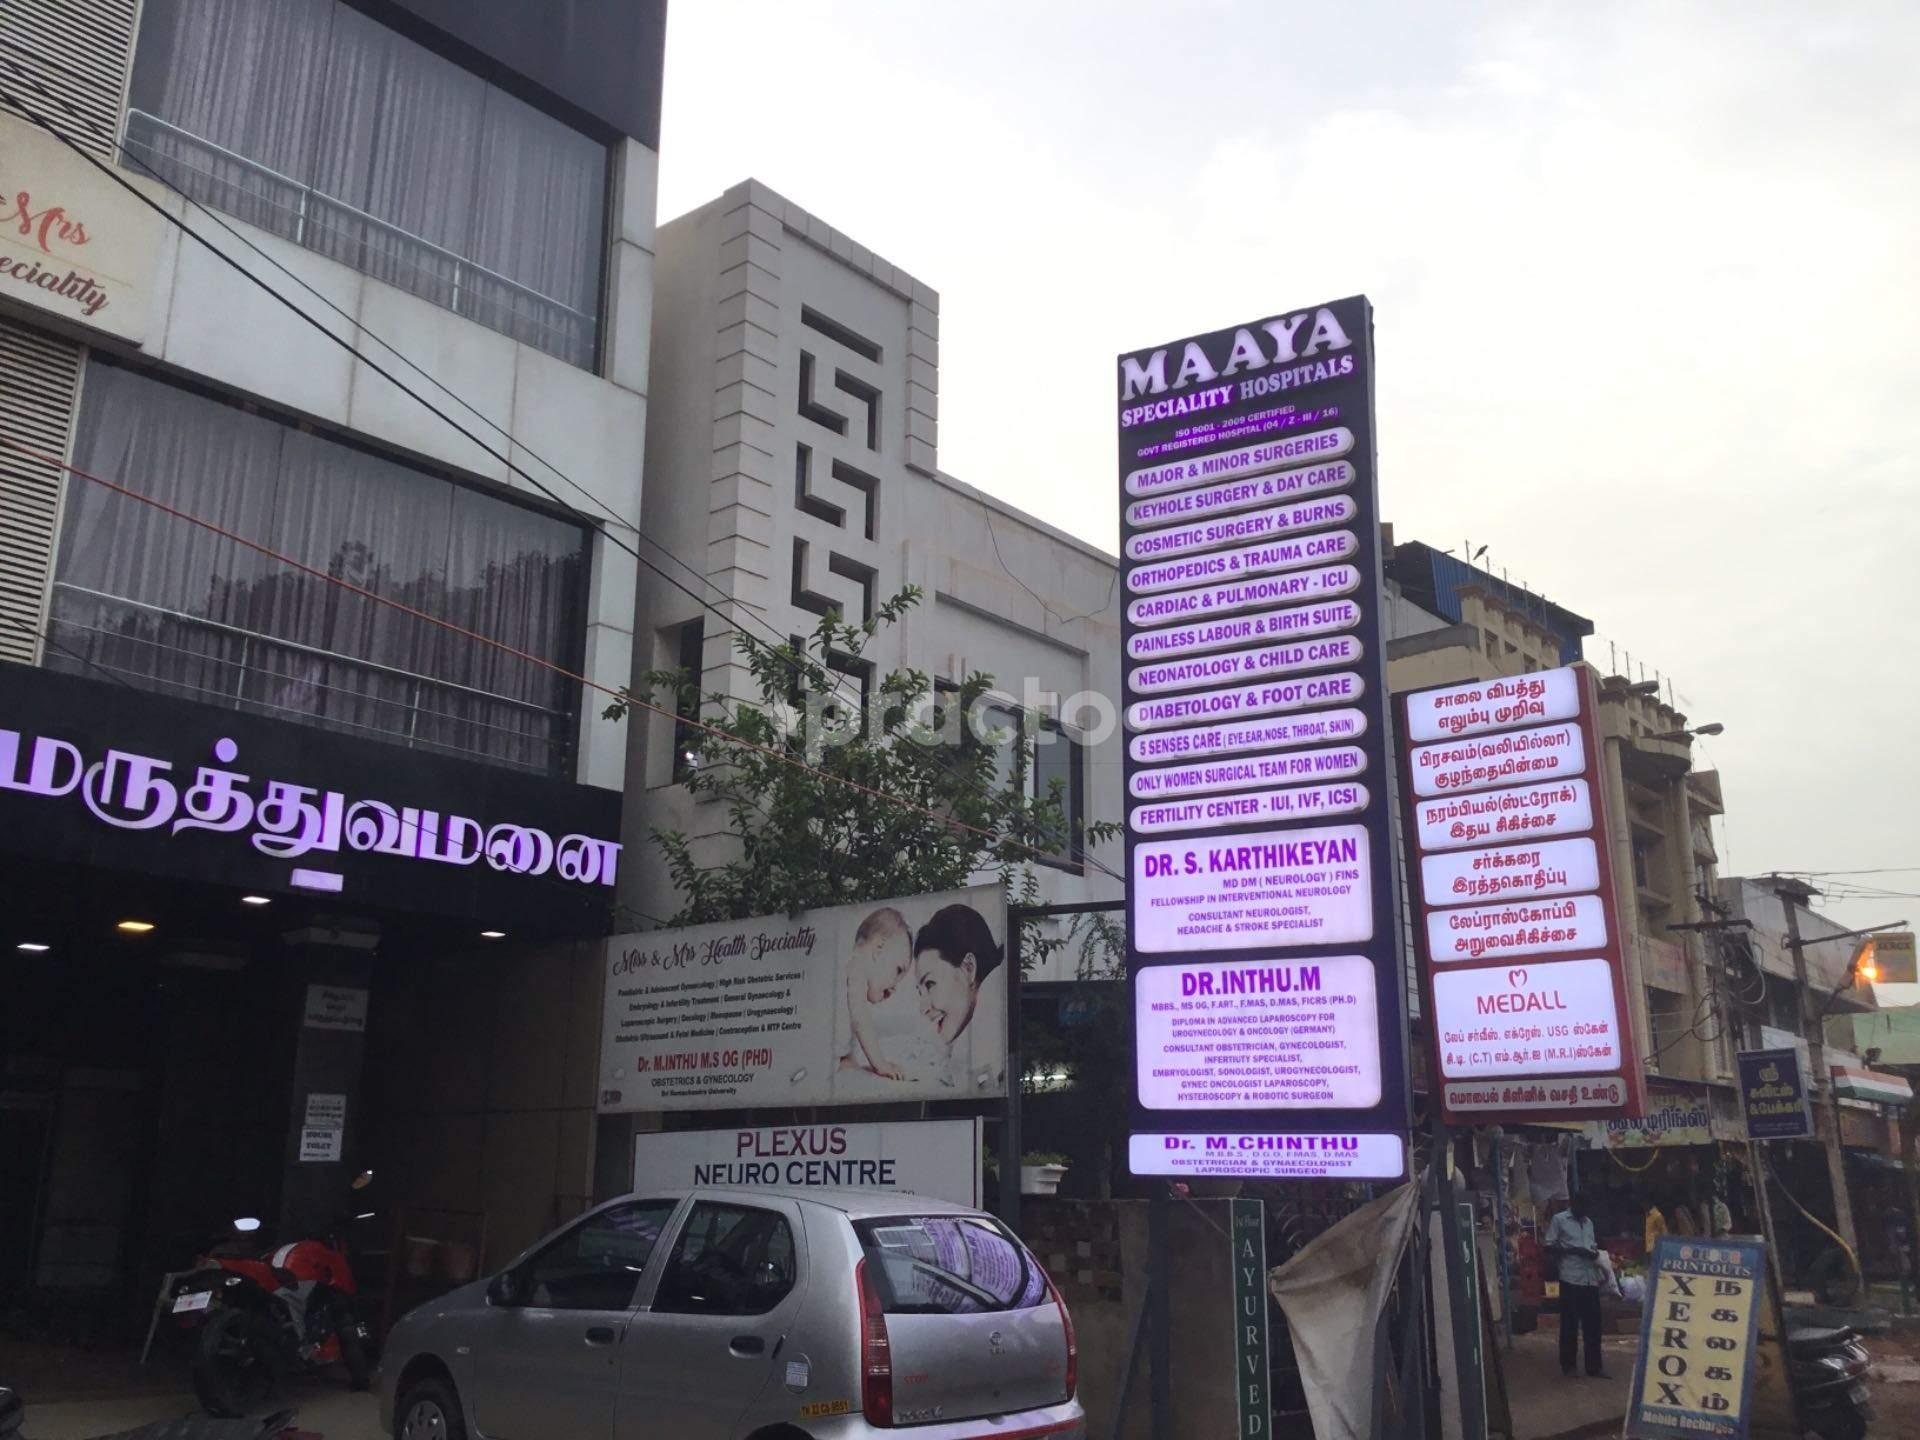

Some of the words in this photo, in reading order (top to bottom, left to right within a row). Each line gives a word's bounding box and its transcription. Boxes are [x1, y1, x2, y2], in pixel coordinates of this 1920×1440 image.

[1121, 308, 1352, 400] MAAYA
[1121, 384, 1231, 427] SPECIALITY
[1240, 355, 1353, 399] HOSPITALS
[1175, 427, 1189, 437] ISO
[1192, 422, 1214, 434] 9001
[1222, 415, 1245, 427] 2009
[1247, 405, 1294, 422] CERTIFIED
[1137, 445, 1160, 457] GOVT
[1161, 433, 1215, 452] REGISTERED
[1218, 423, 1261, 440] HOSPITAL
[1137, 465, 1183, 488] MAJOR
[1202, 451, 1248, 475] MINOR
[1253, 433, 1338, 464] SURGERIES
[1134, 495, 1192, 520] KEYHOLE
[1196, 482, 1258, 508] SURGERY
[1277, 474, 1303, 492] DAY
[1308, 466, 1345, 487] CARE
[1135, 528, 1202, 554] COSMETIC
[1206, 515, 1273, 541] SURGERY
[1293, 502, 1344, 525] BURNS
[1132, 557, 1225, 587] ORTHOPEDICS
[1244, 544, 1301, 567] TRAUMA
[1306, 536, 1345, 556] CARE
[1137, 595, 1197, 617] CARDIAC
[1216, 577, 1309, 605] PULMONARY
[1322, 571, 1347, 589] ICU
[1135, 630, 1194, 653] PAINLESS
[1198, 621, 1250, 643] LABOUR
[1269, 612, 1308, 632] BIRTH
[1313, 605, 1351, 625] SUITE
[1139, 657, 1239, 685] NEONATOLOGY
[1259, 648, 1303, 668] CHILD
[1308, 641, 1349, 661] CARE
[1139, 694, 1241, 721] DIABETOLOGY
[1262, 685, 1302, 705] FOOT
[1306, 679, 1350, 699] CARE
[1434, 689, 1481, 709] சாலை
[1487, 679, 1545, 701] விபத்து
[1439, 708, 1489, 733] எலும்பு
[1495, 701, 1545, 722] முறிவு
[1140, 741, 1145, 755] 5
[1149, 736, 1189, 754] SENSES
[1193, 733, 1220, 750] CARE
[1292, 722, 1327, 740] THROAT,
[1329, 719, 1353, 736] SKIN)
[1420, 729, 1570, 767] பிரசவம்(வலியில்லா)
[1137, 774, 1160, 791] ONLY
[1164, 770, 1202, 788] WOMEN
[1205, 764, 1256, 783] SURGICAL
[1259, 760, 1286, 777] TEAM
[1290, 757, 1311, 774] FOR
[1315, 752, 1357, 771] WOMEN
[1435, 755, 1558, 789] குழந்தையின்மை
[0, 729, 623, 886] மருத்துவமனை
[1140, 804, 1202, 824] FERTILITY
[1207, 798, 1258, 818] CENTER
[1271, 795, 1293, 811] IUI,
[1298, 792, 1324, 809] IVF,
[1328, 788, 1357, 806] ICSI
[1426, 786, 1577, 825] நரம்பியல்(ஸ்ட்ரோக்)
[1450, 822, 1490, 840] இதய
[1496, 812, 1556, 834] சிகிச்சை
[1145, 852, 1177, 877] DR.
[1184, 850, 1202, 874] S.
[1209, 838, 1356, 872] KARTHIKEYAN
[1473, 851, 1540, 870] சர்க்கரை
[1223, 878, 1238, 889] MD
[1241, 877, 1256, 888] DM
[1335, 869, 1358, 882] FINS
[1452, 868, 1566, 896] இரத்தகொதிப்பு
[1151, 894, 1204, 907] FELLOWSHIP
[1207, 894, 1215, 904] IN
[1218, 889, 1292, 903] INTERVENTIONAL
[1295, 885, 1350, 898] NEUROLOGY
[1177, 923, 1222, 935] HEADACHE
[1234, 921, 1268, 932] STROKE
[1271, 918, 1322, 930] SPECIALIST
[1189, 909, 1242, 921] CONSULTANT
[1245, 906, 1310, 919] NEUROLOGIST,
[1449, 901, 1576, 930] லேப்ராஸ்கோப்பி
[613, 949, 646, 975] Miss
[663, 943, 696, 970] Mrs
[701, 934, 747, 965] Health
[751, 926, 815, 960] Speciality
[1454, 926, 1577, 957] அறுவைசிகிச்சை
[1182, 966, 1320, 996] DR.INTHU.M
[1181, 1001, 1193, 1011] MS
[1302, 996, 1326, 1007] FICRS
[1476, 991, 1567, 1014] MEDALL
[1172, 1017, 1204, 1026] DIPLOMA
[1207, 1017, 1214, 1025] IN
[1217, 1015, 1257, 1025] ADVANCED
[1260, 1013, 1316, 1024] LAPAROSCOPY
[1319, 1013, 1334, 1022] FOR
[1172, 1027, 1236, 1038] UROGYNECOLOGY
[1247, 1026, 1288, 1036] ONCOLOGY
[1291, 1025, 1334, 1035] (GERMANY)
[1547, 1026, 1569, 1037] USG
[1573, 1021, 1609, 1035] ஸ்கேன்
[638, 1057, 650, 1072] Dr.
[654, 1053, 698, 1071] M.INTHU
[701, 1051, 719, 1068] M.S
[723, 1050, 738, 1067] OG
[742, 1048, 772, 1070] (PHD)
[1163, 1044, 1213, 1053] CONSULTANT
[1216, 1042, 1276, 1052] OBSTETRICIAN,
[1279, 1041, 1346, 1051] GYNECOLOGIST,
[1252, 1055, 1302, 1063] SPECIALIST,
[651, 1075, 694, 1087] OBSTETRICS
[703, 1073, 754, 1084] GYNECOLOGY
[1152, 1068, 1214, 1077] EMBRYOLOGIST,
[1218, 1067, 1272, 1077] SONOLOGIST,
[1274, 1065, 1360, 1076] UROGYNECOLOGIST,
[1181, 1080, 1207, 1089] GYNEC
[1209, 1080, 1261, 1089] ONCOLOGIST
[1264, 1079, 1328, 1088] LAPAROSCOPY,
[1178, 1092, 1241, 1101] HYSTEROSCOPY
[1252, 1091, 1288, 1101] ROBOTIC
[1291, 1091, 1333, 1100] SURGEON
[1581, 1084, 1619, 1103] உண்டு
[736, 1128, 848, 1158] PLEXUS
[1165, 1137, 1195, 1150] Dr.
[1205, 1137, 1358, 1150] M.CHINTHU
[694, 1162, 780, 1186] NEURO
[786, 1159, 896, 1186] CENTRE
[1662, 1259, 1751, 1276] PRINTOUTS
[1655, 1275, 1696, 1406] XEROX
